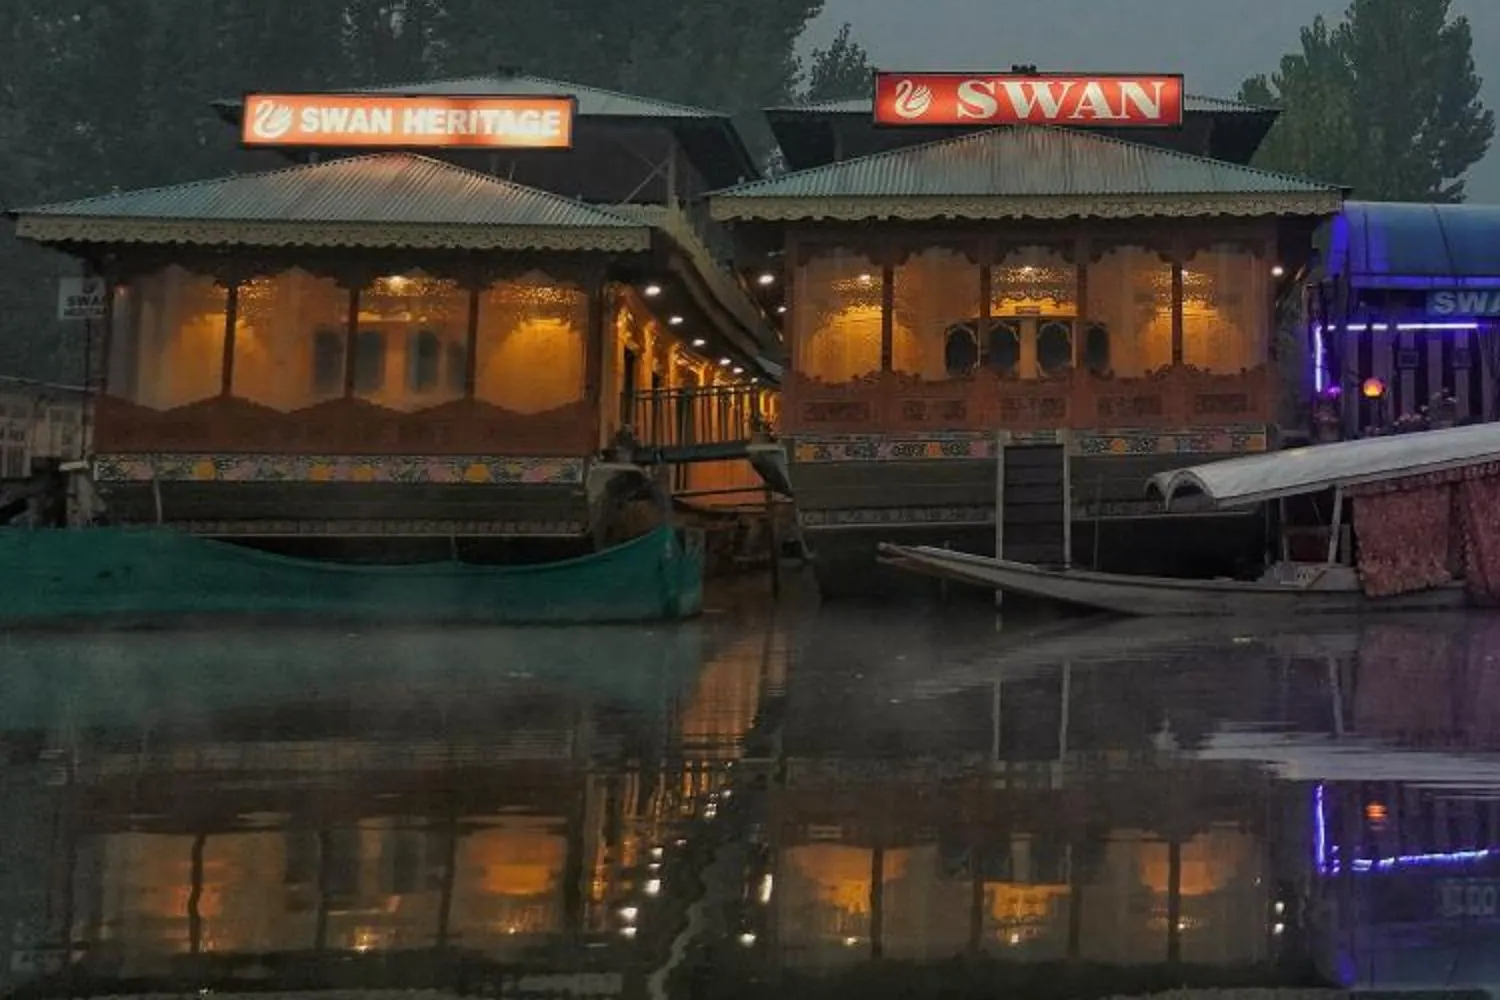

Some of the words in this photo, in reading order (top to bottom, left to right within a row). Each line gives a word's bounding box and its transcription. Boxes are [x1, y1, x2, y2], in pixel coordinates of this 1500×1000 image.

[957, 79, 1164, 119] SWAN
[300, 107, 392, 133] SWAN
[403, 107, 561, 136] HERITAGE
